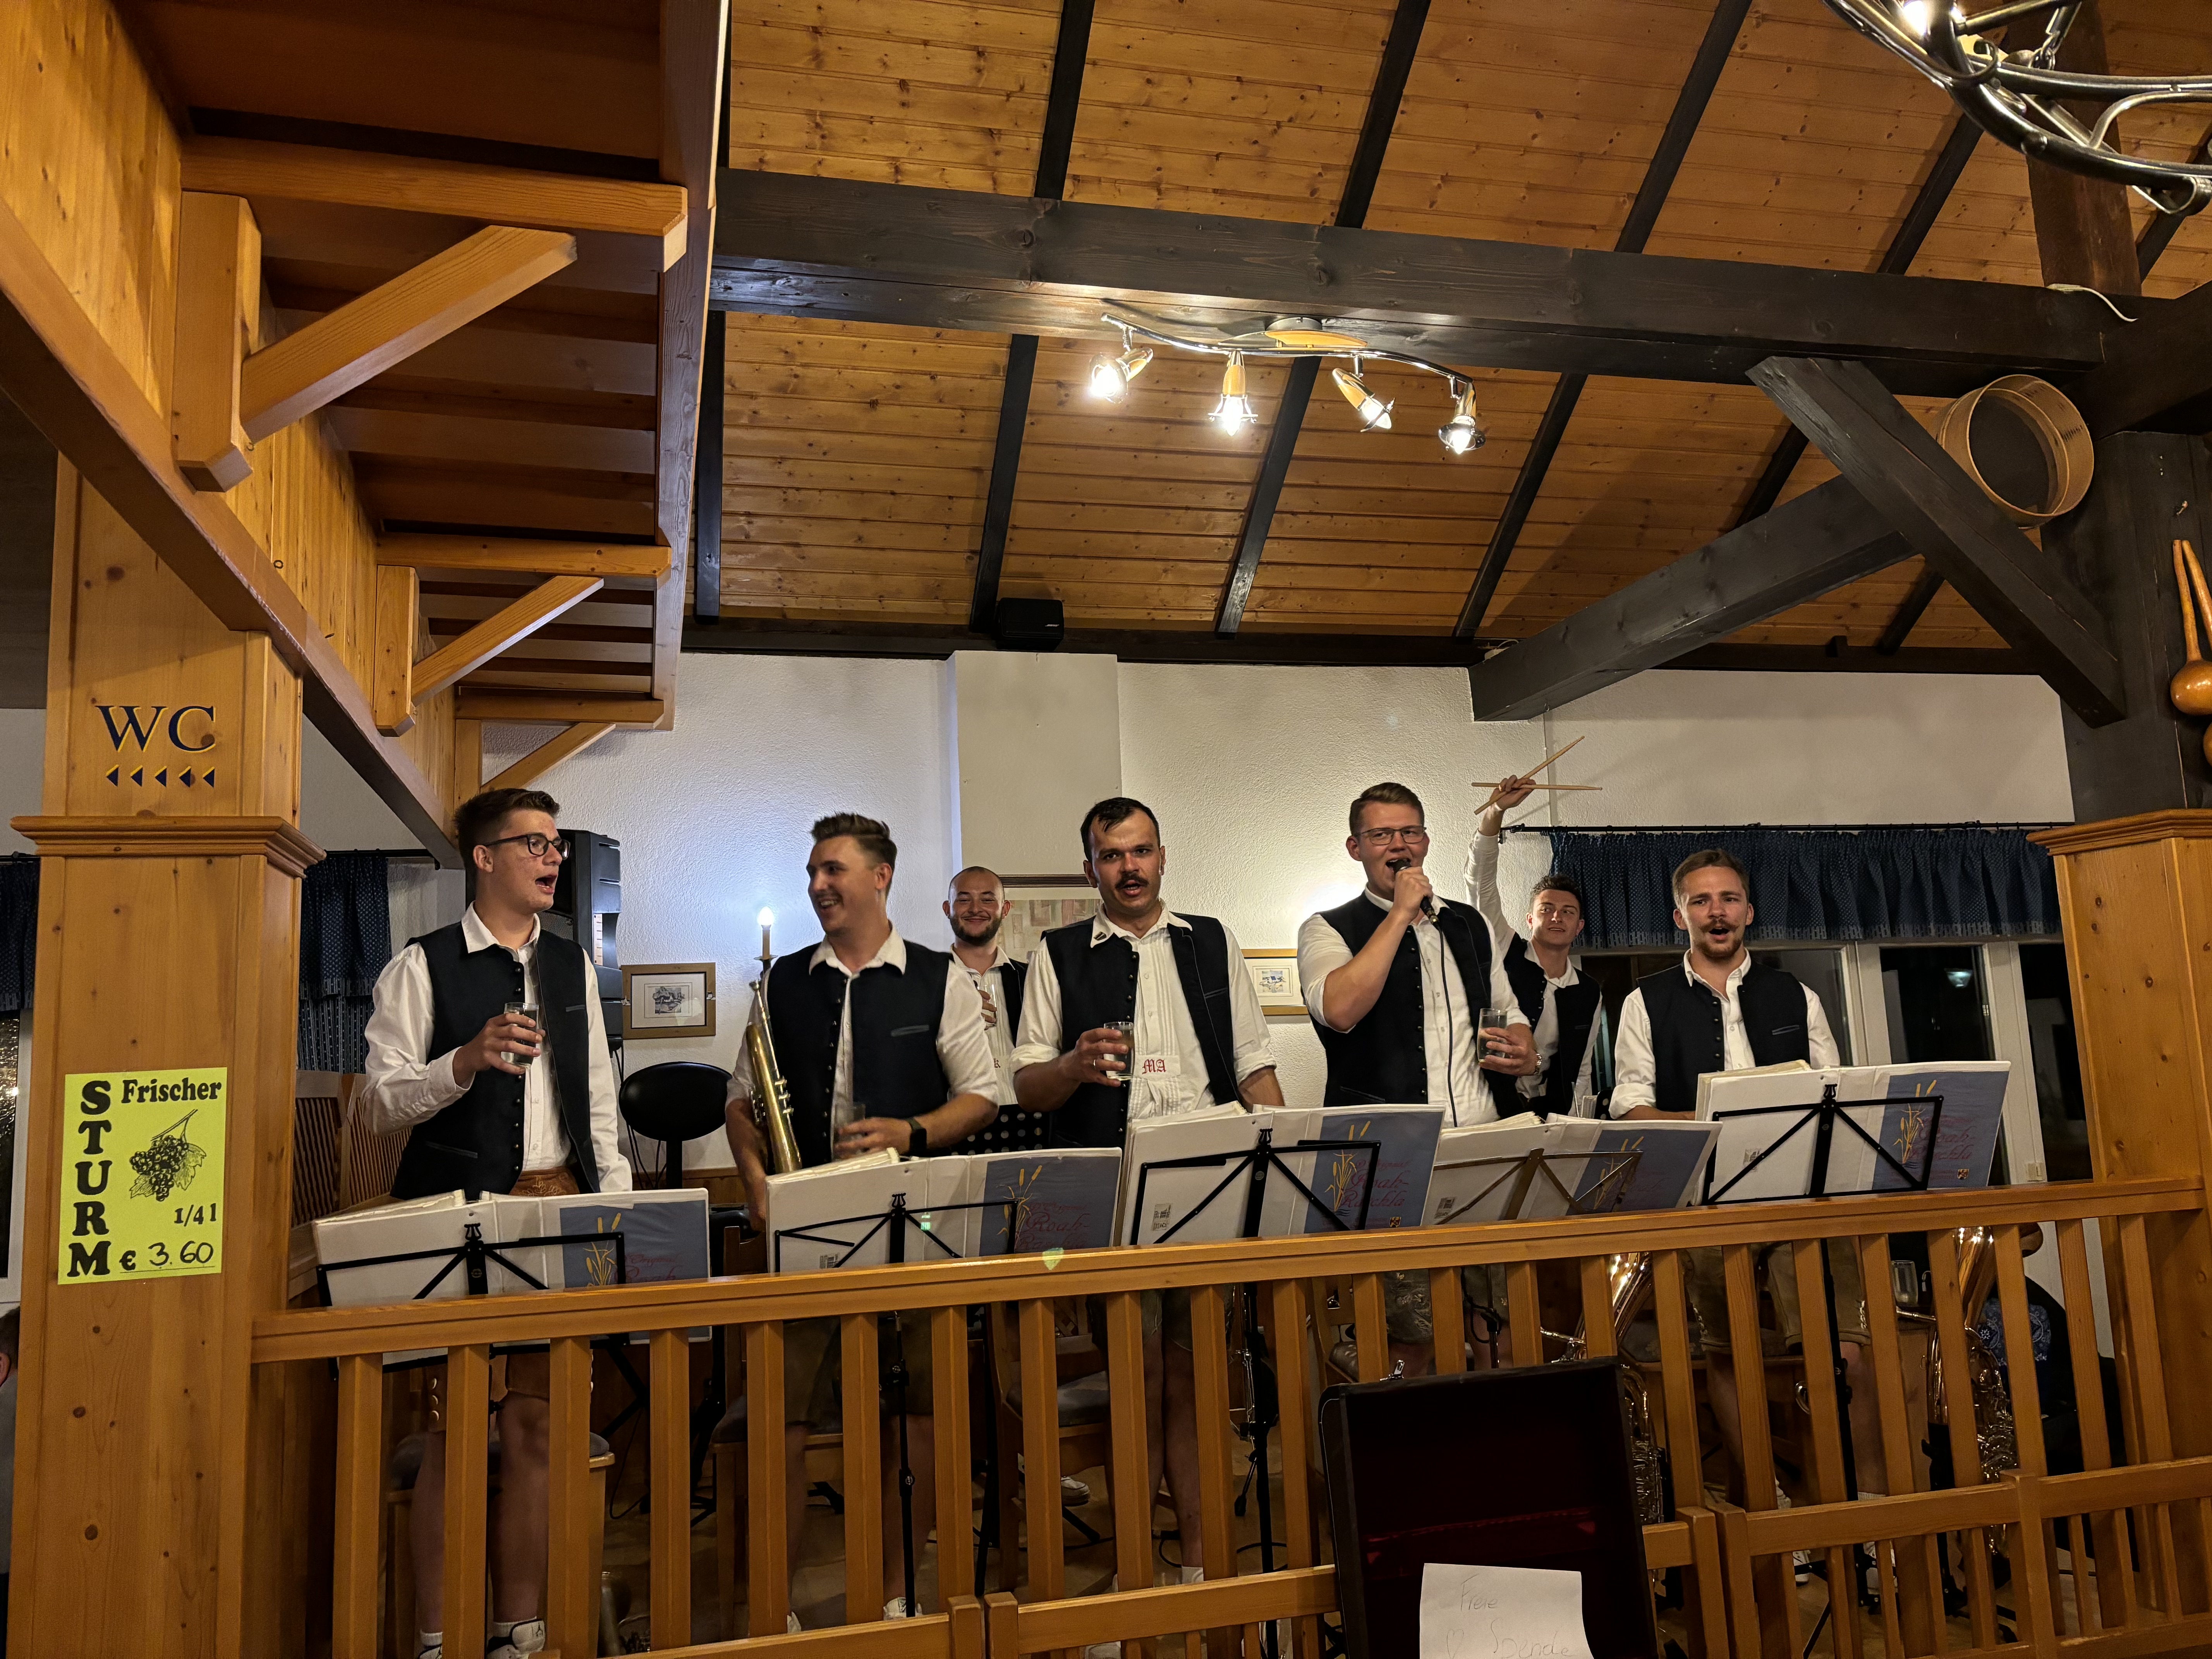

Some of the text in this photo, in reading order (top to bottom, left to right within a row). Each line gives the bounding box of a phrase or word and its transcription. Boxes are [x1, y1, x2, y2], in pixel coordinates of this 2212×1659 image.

[94, 706, 216, 753] WC
[1142, 1059, 1166, 1075] MA
[121, 1077, 222, 1104] Frischer
[67, 1080, 112, 1277] STURM
[119, 1241, 214, 1271] € 3.60
